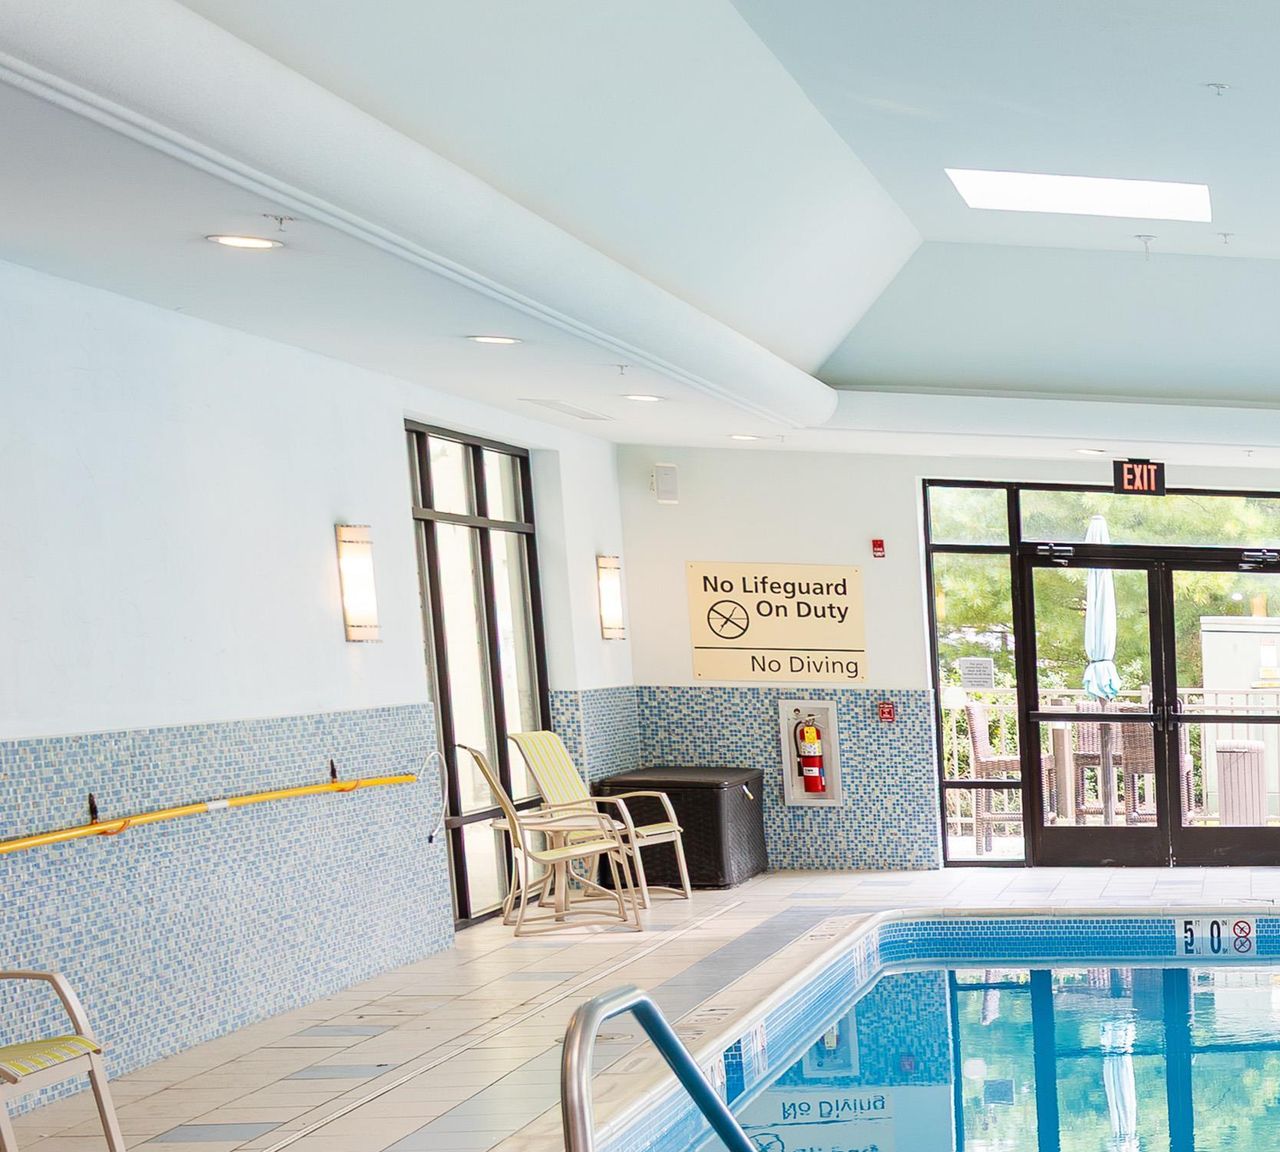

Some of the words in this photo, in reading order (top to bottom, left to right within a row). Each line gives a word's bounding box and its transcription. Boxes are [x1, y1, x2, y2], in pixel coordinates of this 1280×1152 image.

[1123, 463, 1157, 491] EXIT
[703, 575, 734, 593] No
[742, 576, 848, 599] Lifeguard
[756, 600, 788, 618] On
[796, 601, 849, 624] Duty
[751, 655, 781, 673] No
[789, 656, 859, 679] Diving
